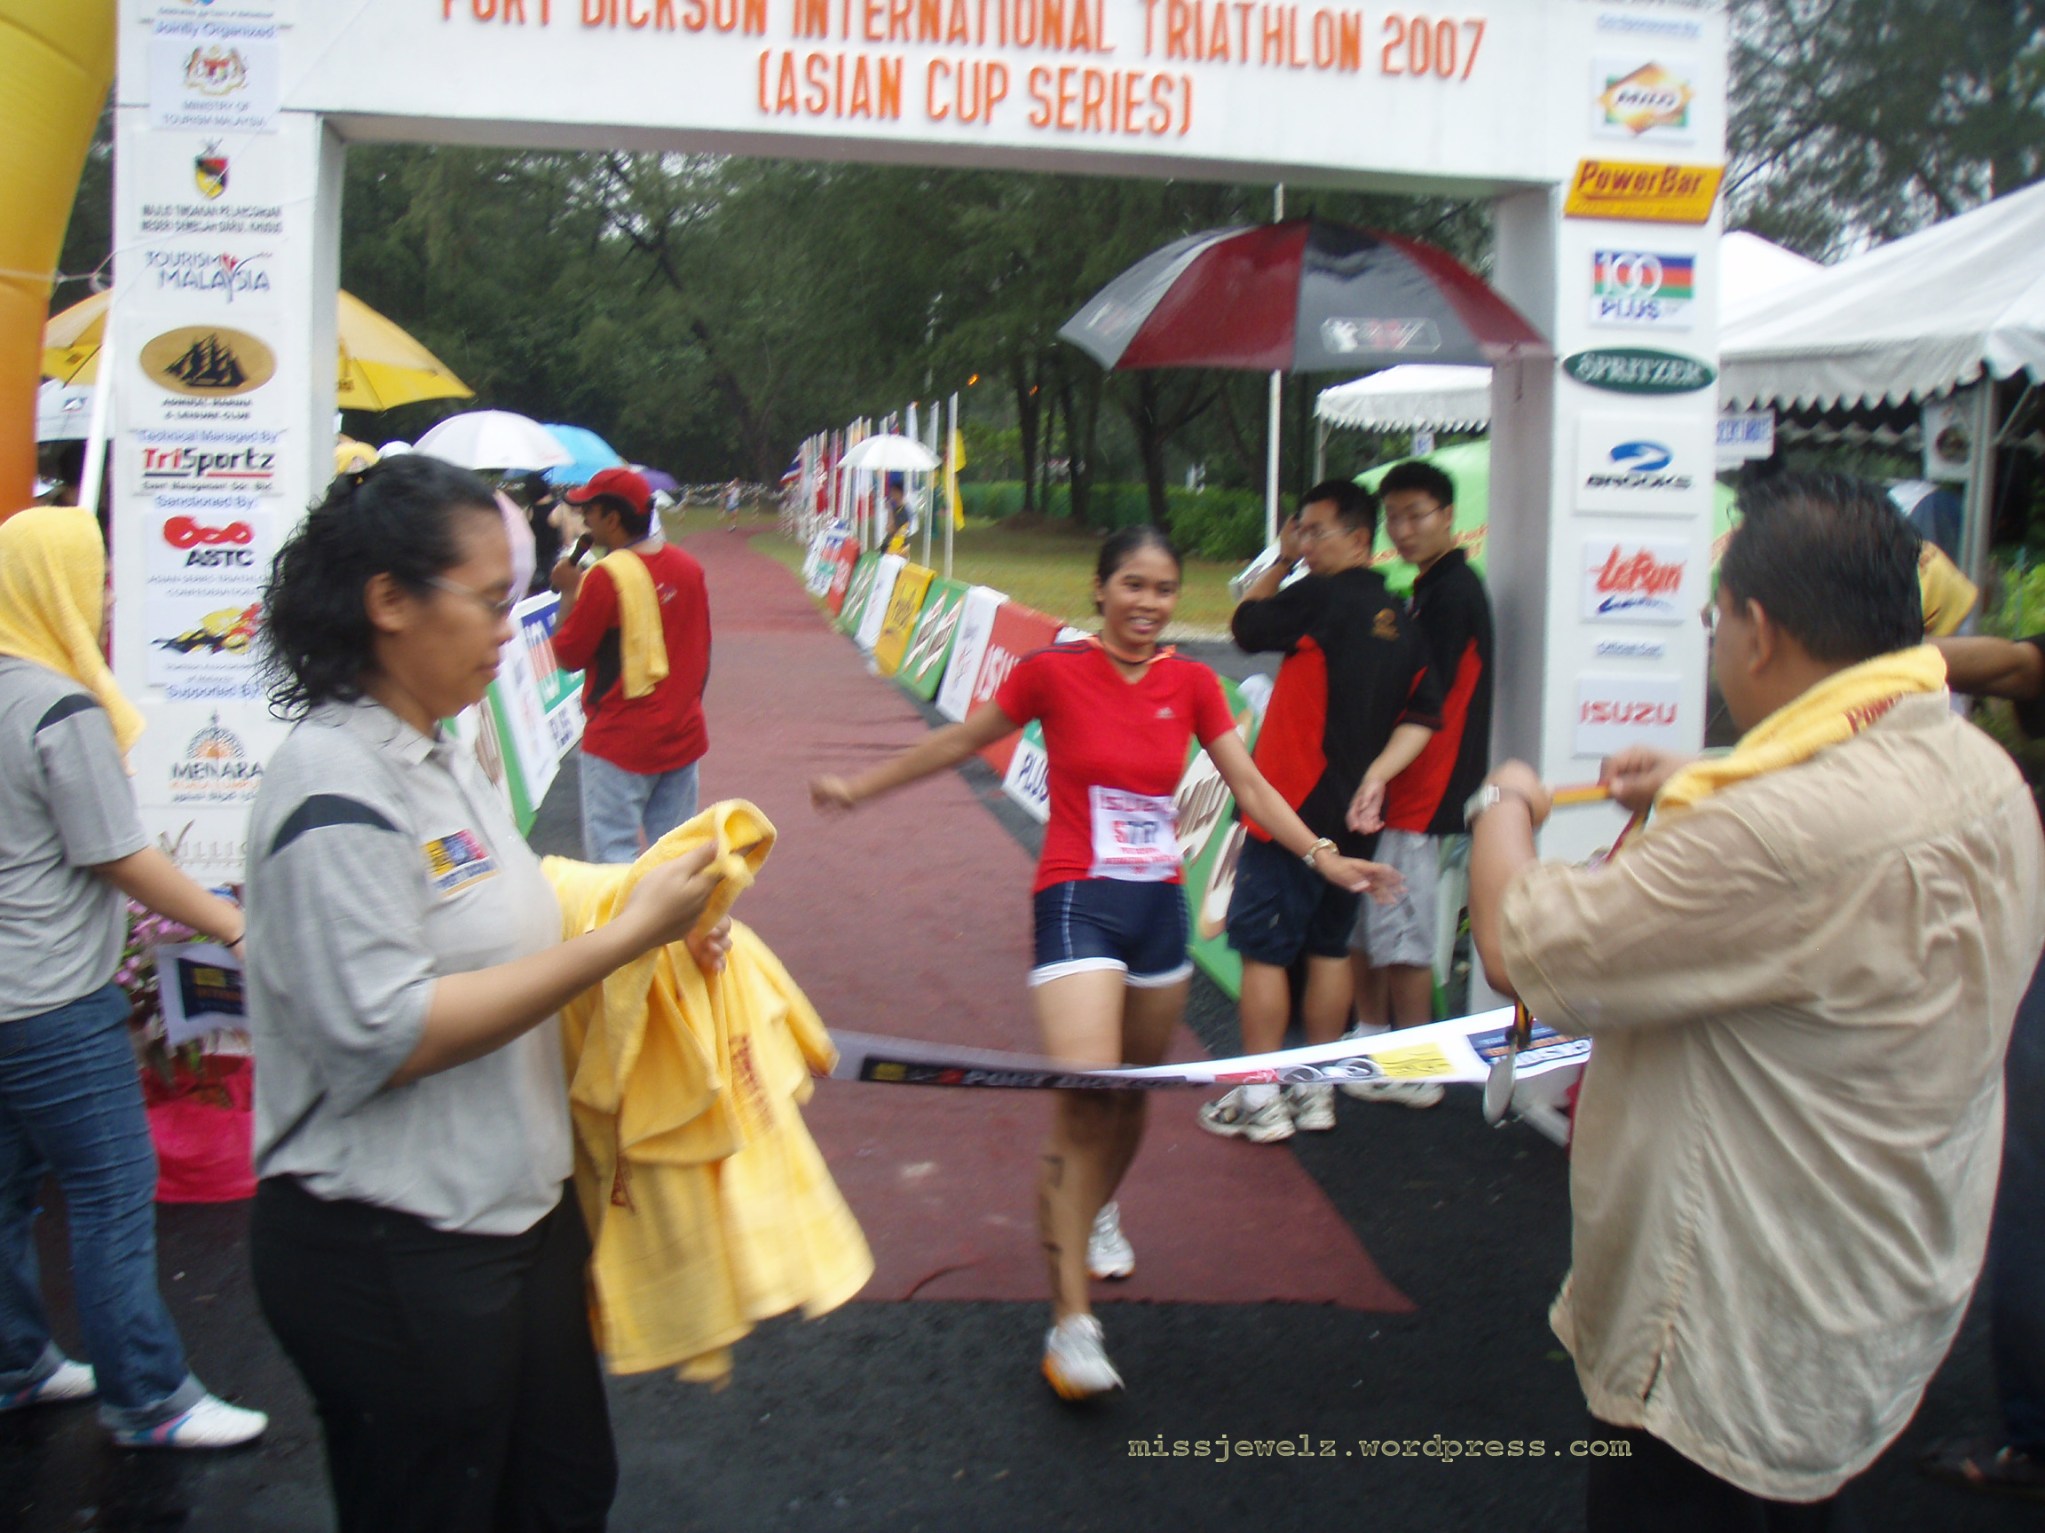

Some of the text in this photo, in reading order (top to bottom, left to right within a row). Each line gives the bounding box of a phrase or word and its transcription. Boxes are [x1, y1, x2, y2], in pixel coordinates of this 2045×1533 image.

[1141, 0, 1362, 71] TRIATHLON
[1381, 13, 1486, 80] 2007
[758, 48, 1193, 136] (ASIAN CUP SERIES)
[1578, 160, 1705, 195] PowerBar
[146, 251, 222, 268] TOURISM
[158, 264, 271, 303] MALAYSIA
[1601, 301, 1661, 319] PLUS
[144, 448, 276, 478] TriSportz
[186, 550, 254, 567] ASTC
[1580, 700, 1678, 725] ISUZU
[173, 762, 265, 779] MENARA
